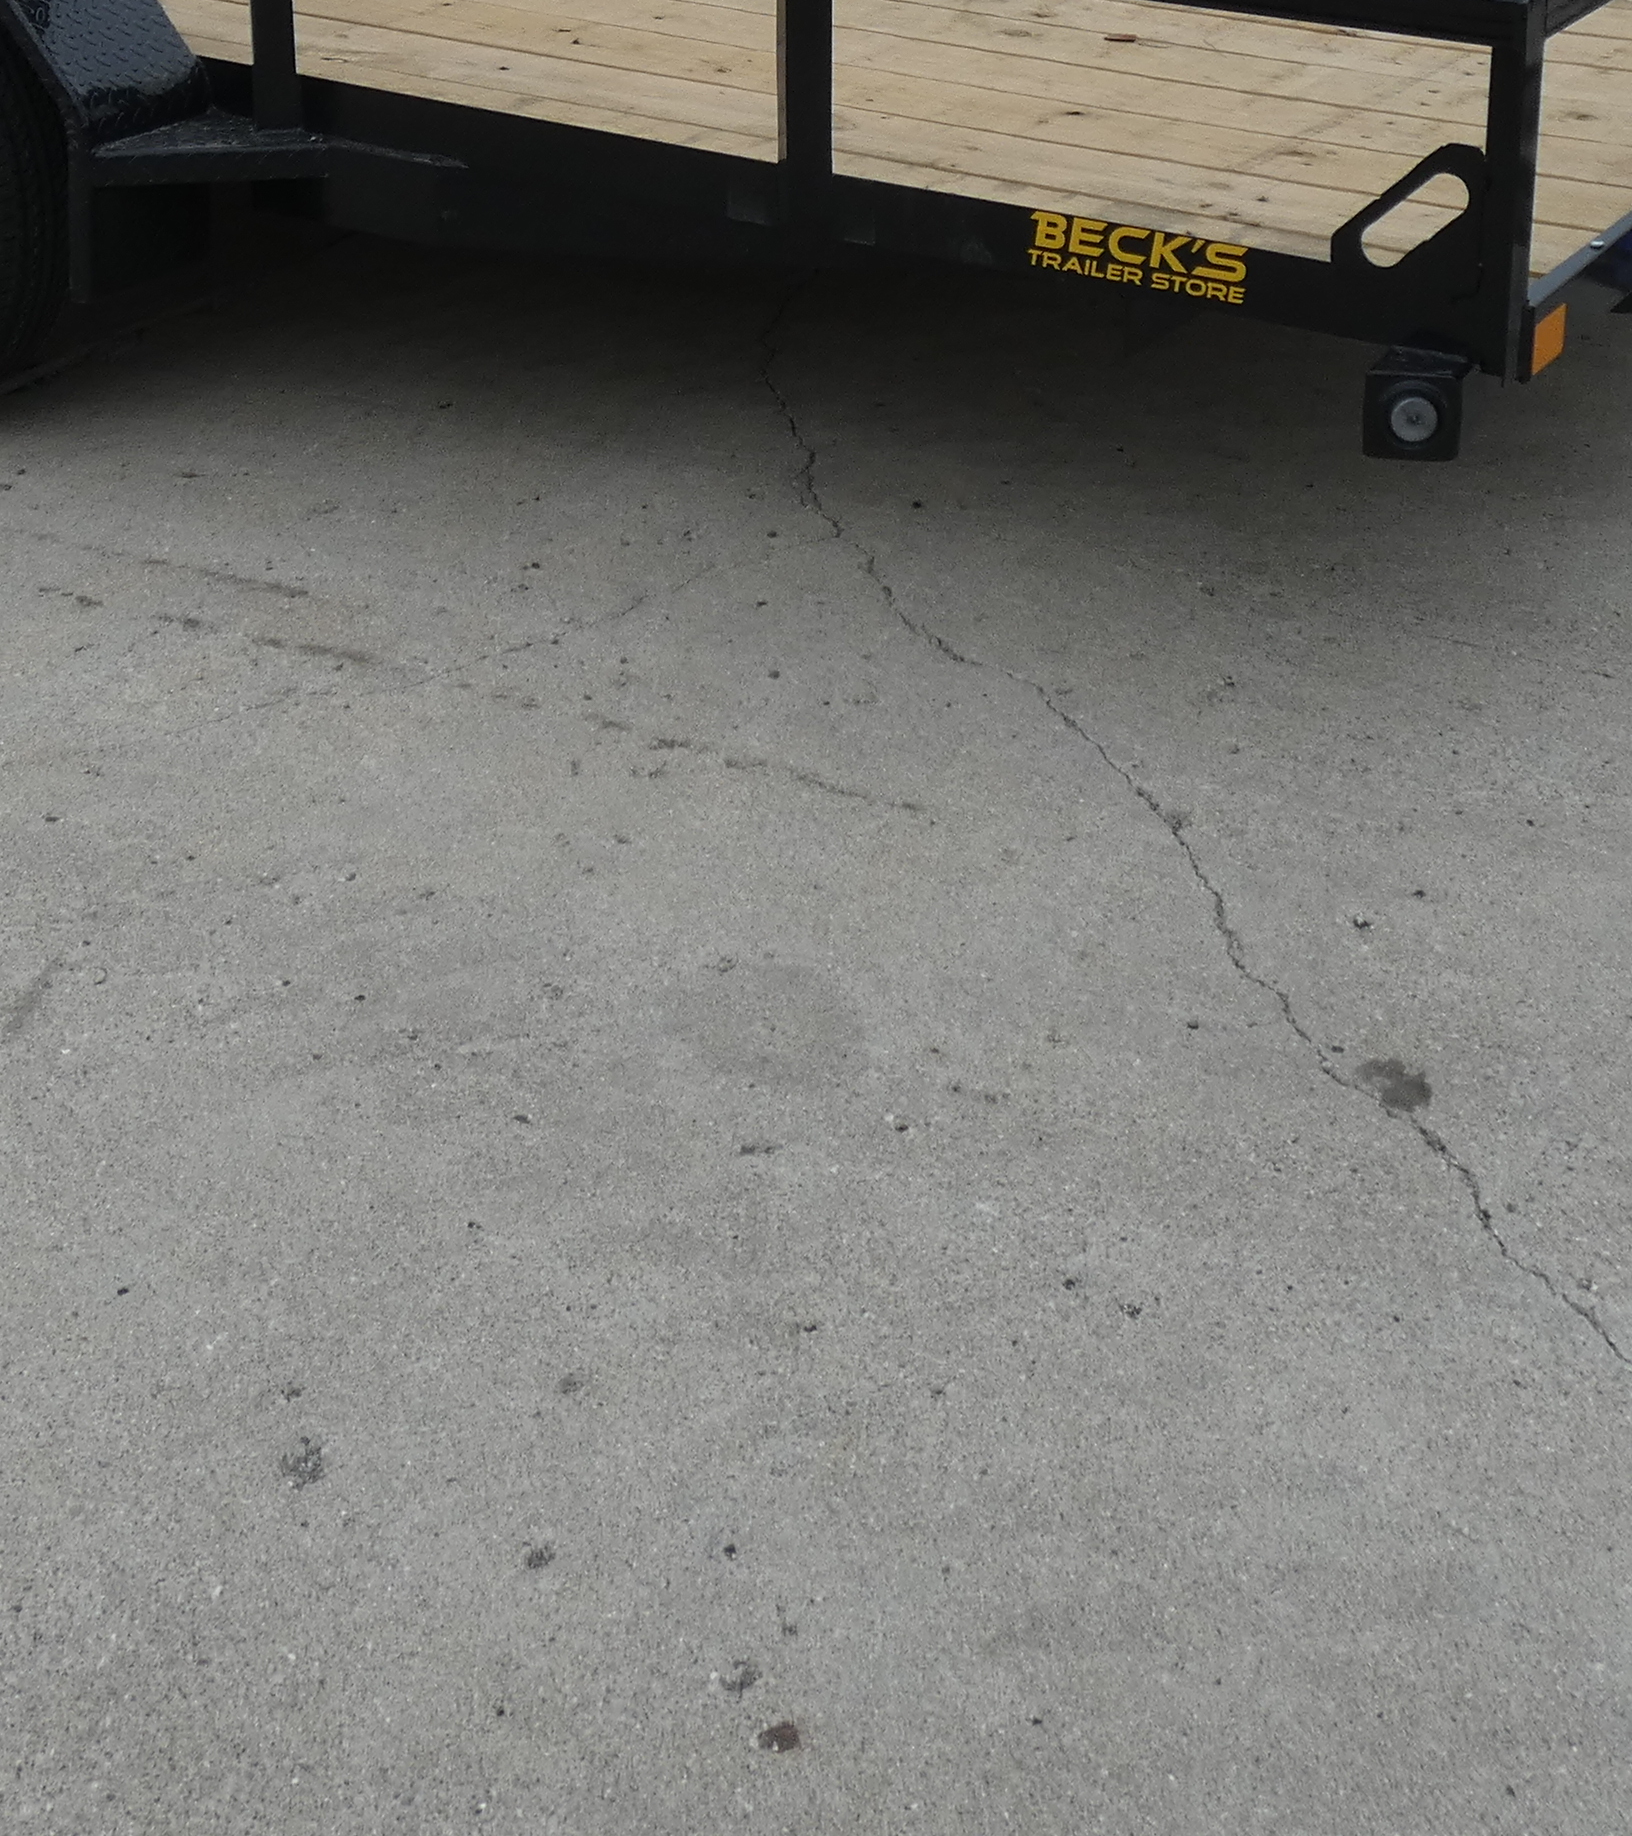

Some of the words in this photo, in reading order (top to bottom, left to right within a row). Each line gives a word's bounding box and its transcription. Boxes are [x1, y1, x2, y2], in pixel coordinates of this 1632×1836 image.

[1027, 249, 1143, 286] TRAILER
[1150, 272, 1246, 304] STORE
[1029, 211, 1249, 283] BECK'S
